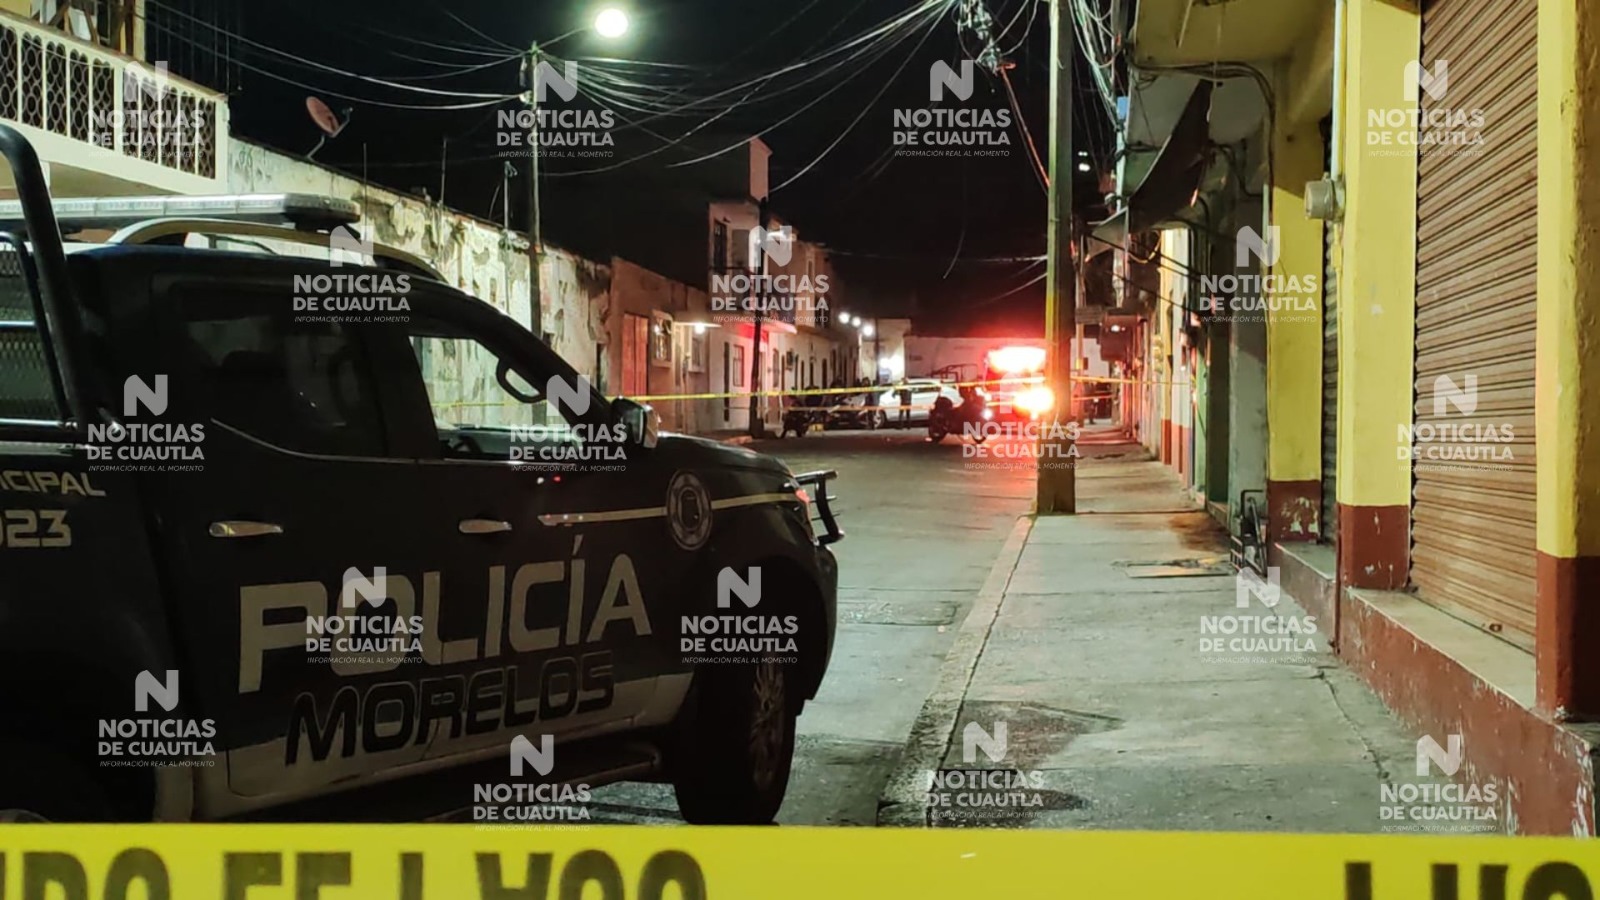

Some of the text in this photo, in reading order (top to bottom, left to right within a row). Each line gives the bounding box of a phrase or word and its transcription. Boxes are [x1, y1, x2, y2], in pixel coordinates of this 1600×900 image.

[0, 509, 72, 548] 23
[238, 534, 653, 694] POLICÍA
[284, 651, 615, 767] MORELOS
